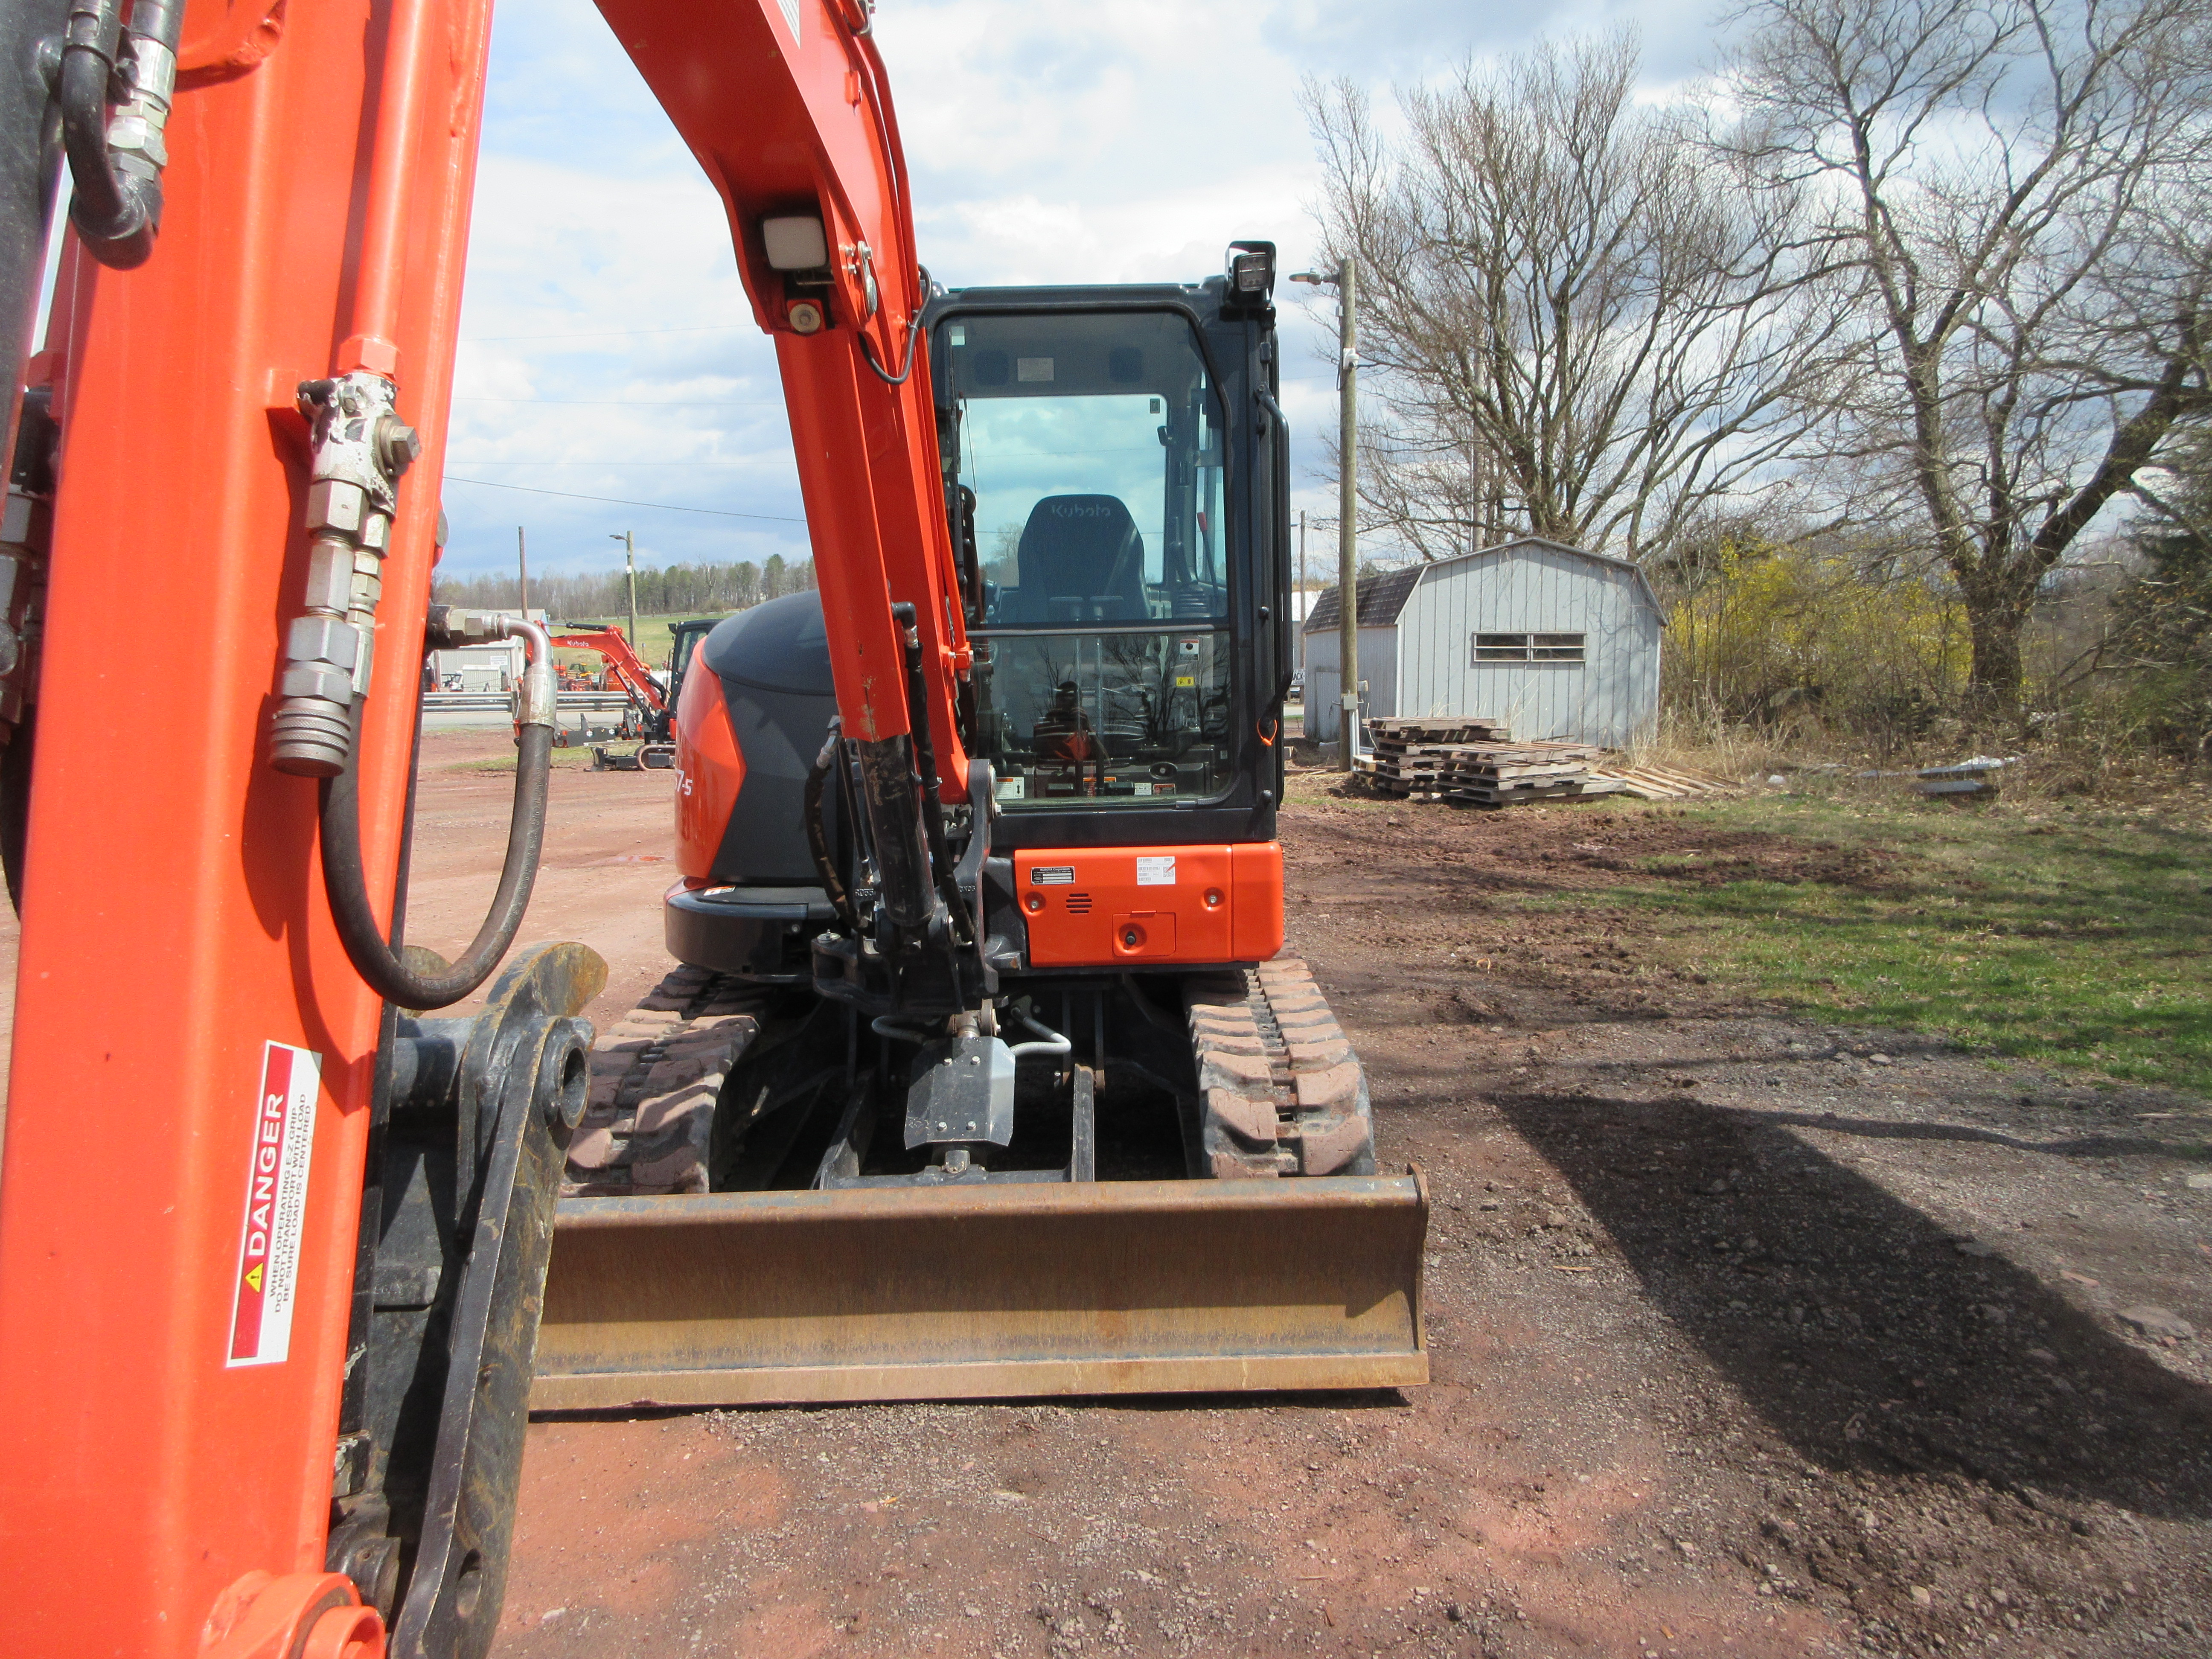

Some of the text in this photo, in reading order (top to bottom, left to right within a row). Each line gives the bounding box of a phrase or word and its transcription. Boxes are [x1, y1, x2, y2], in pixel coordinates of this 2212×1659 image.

[1052, 504, 1111, 517] Kubota
[248, 1094, 284, 1256] DANGER
[270, 1108, 297, 1297] WHEN OPERATING E-Z GRIP
[275, 1094, 306, 1313] DO NOT TRANSPORT WITH LOAD
[283, 1105, 311, 1302] BE SURE LOAD IS CENTERED
